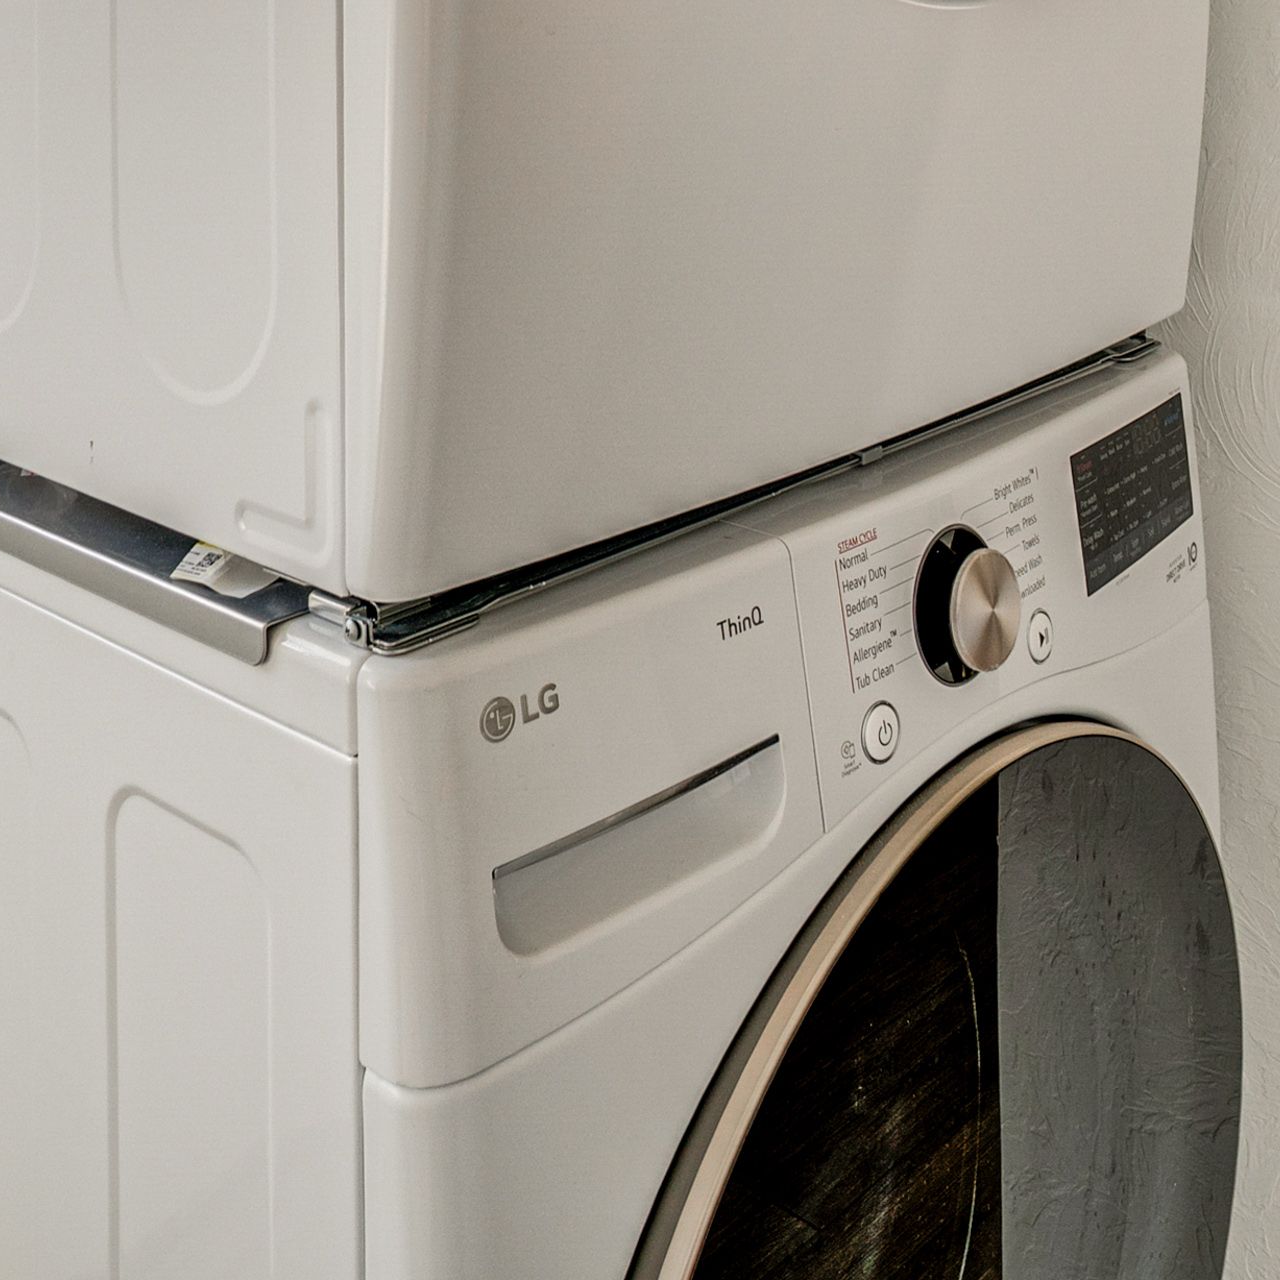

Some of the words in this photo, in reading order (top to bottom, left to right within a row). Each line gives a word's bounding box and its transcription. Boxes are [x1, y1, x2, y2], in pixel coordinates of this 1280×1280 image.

[993, 484, 1012, 501] Bright
[1009, 493, 1034, 514] Delicates
[1022, 513, 1038, 529] Press
[837, 535, 859, 552] STEAM
[858, 527, 878, 545] CYCLE
[1021, 534, 1041, 552] Towels
[838, 550, 868, 571] Normal
[1029, 555, 1043, 569] Wash
[841, 575, 867, 593] Heavy
[867, 565, 887, 582] Duty
[845, 593, 879, 618] Bedding
[716, 605, 764, 641] ThinQ
[849, 618, 883, 642] Sanitary
[855, 674, 870, 692] Tub
[871, 663, 895, 682] Clean
[520, 683, 560, 724] LG
